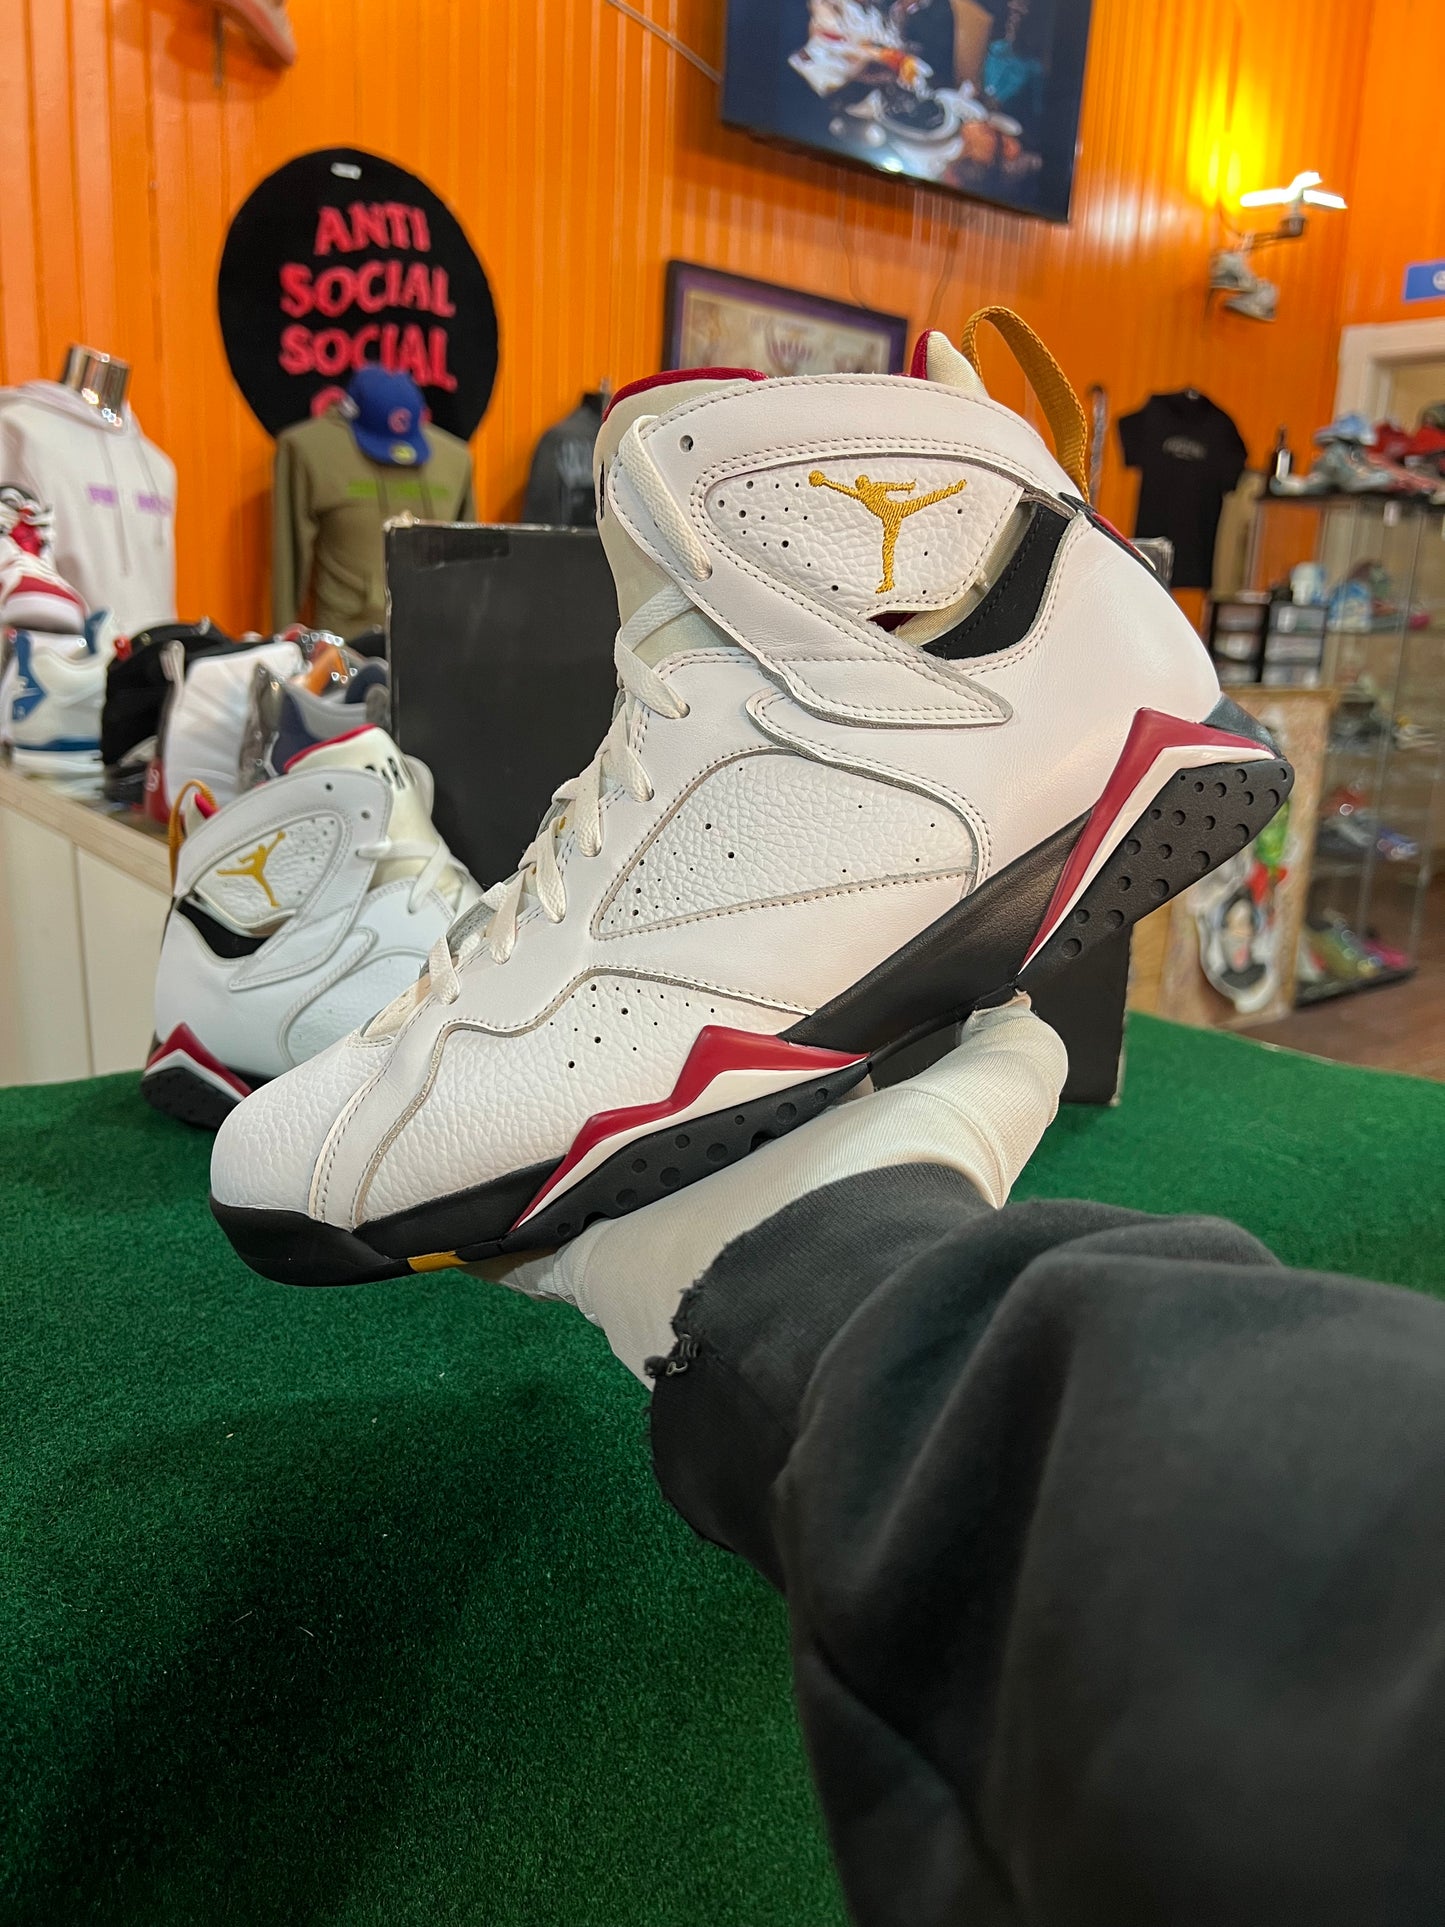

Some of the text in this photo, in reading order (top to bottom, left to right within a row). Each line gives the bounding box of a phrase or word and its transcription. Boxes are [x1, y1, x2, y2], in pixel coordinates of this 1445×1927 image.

[314, 202, 431, 255] ANTI
[279, 261, 456, 318] SOCIAL
[279, 323, 457, 392] SOCIAL
